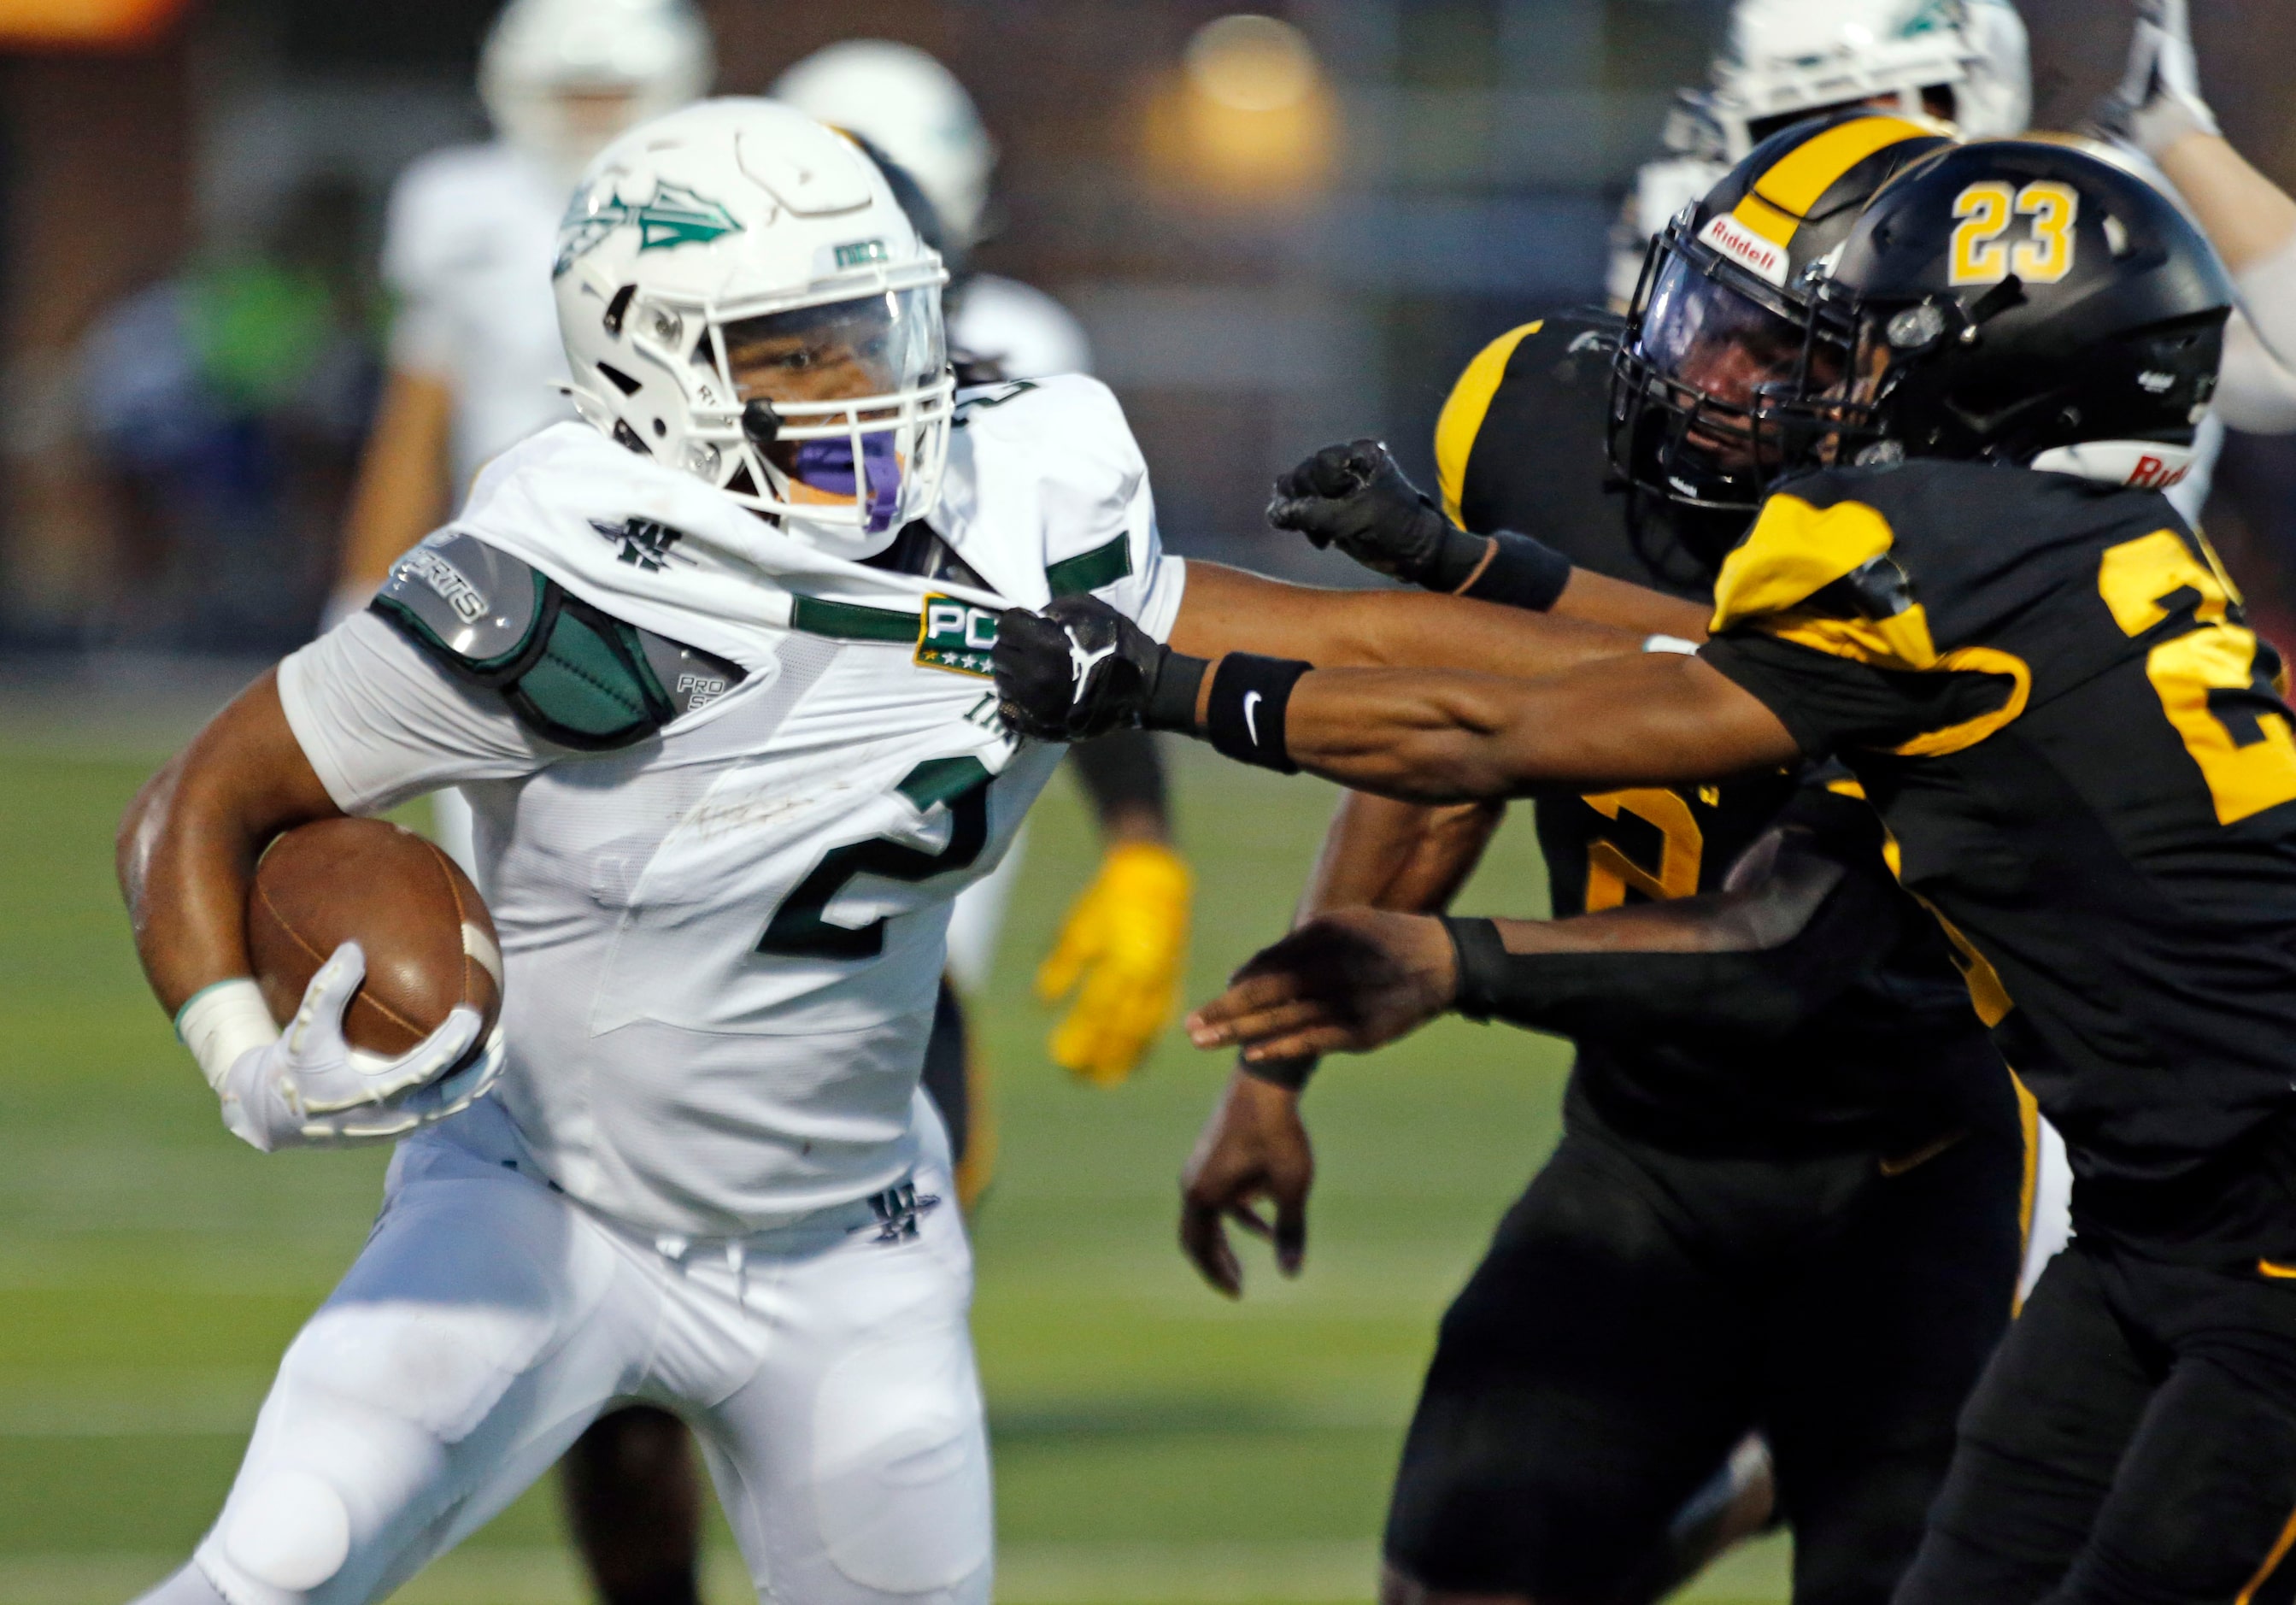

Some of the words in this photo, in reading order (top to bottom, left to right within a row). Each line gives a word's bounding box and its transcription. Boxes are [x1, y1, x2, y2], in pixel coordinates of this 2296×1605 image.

[1712, 220, 1776, 271] Riddell
[1949, 180, 2078, 286] 23
[677, 673, 725, 696] PRO
[754, 755, 998, 959] 2
